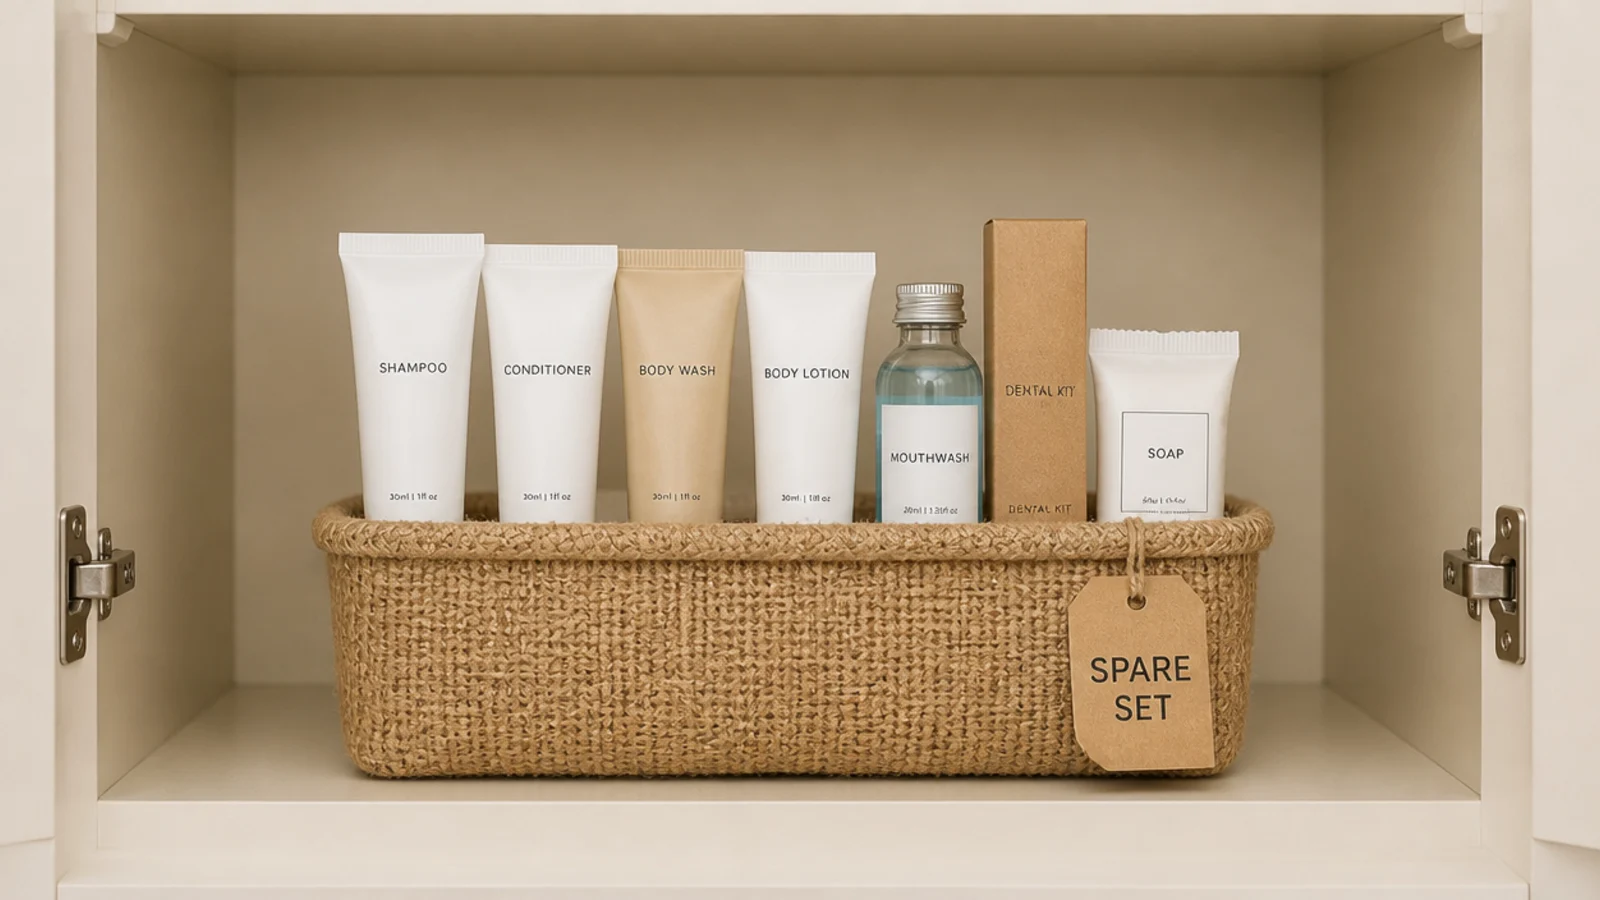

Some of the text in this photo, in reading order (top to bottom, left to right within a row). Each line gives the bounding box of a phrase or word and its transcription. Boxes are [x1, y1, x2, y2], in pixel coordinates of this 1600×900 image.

[379, 361, 448, 374] SHAMPOO
[503, 363, 592, 376] CONDITIONER
[639, 364, 716, 377] BODY WASH
[764, 367, 850, 380] BODY LOTION
[1005, 384, 1053, 397] DENTAL
[890, 451, 970, 464] MOUTHWASH
[1147, 447, 1185, 460] SOAP
[1008, 503, 1073, 514] DENTAL KIT
[1090, 655, 1192, 684] SPARE
[1114, 693, 1172, 722] SET
